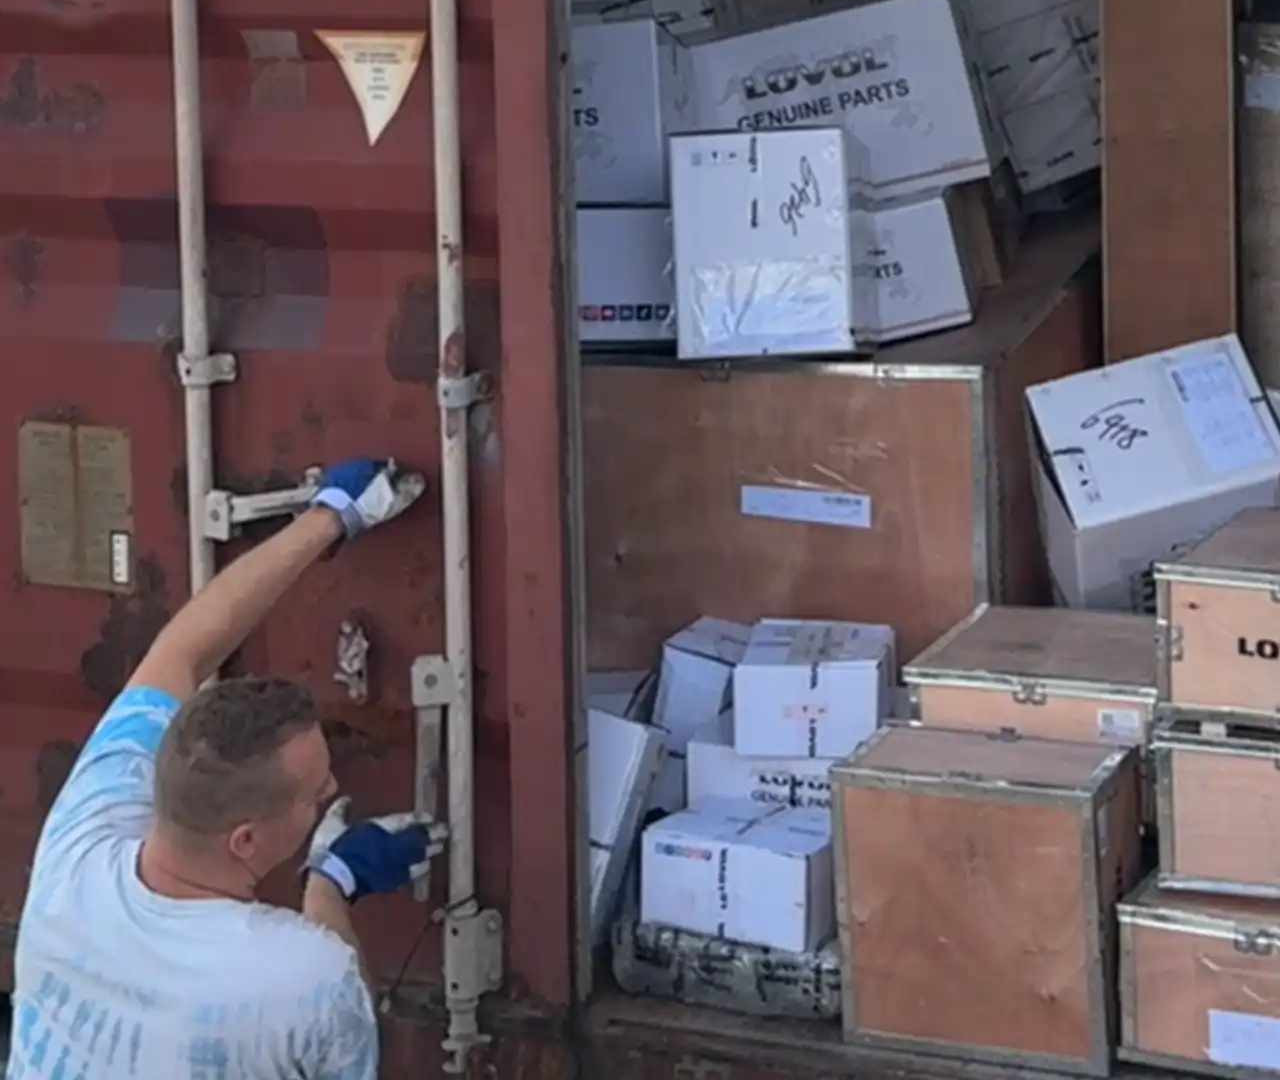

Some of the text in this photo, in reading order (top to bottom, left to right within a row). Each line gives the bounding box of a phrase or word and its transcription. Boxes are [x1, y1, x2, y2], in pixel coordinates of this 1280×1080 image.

[741, 46, 889, 101] LOVOL
[737, 77, 910, 131] GENUINE PARTS
